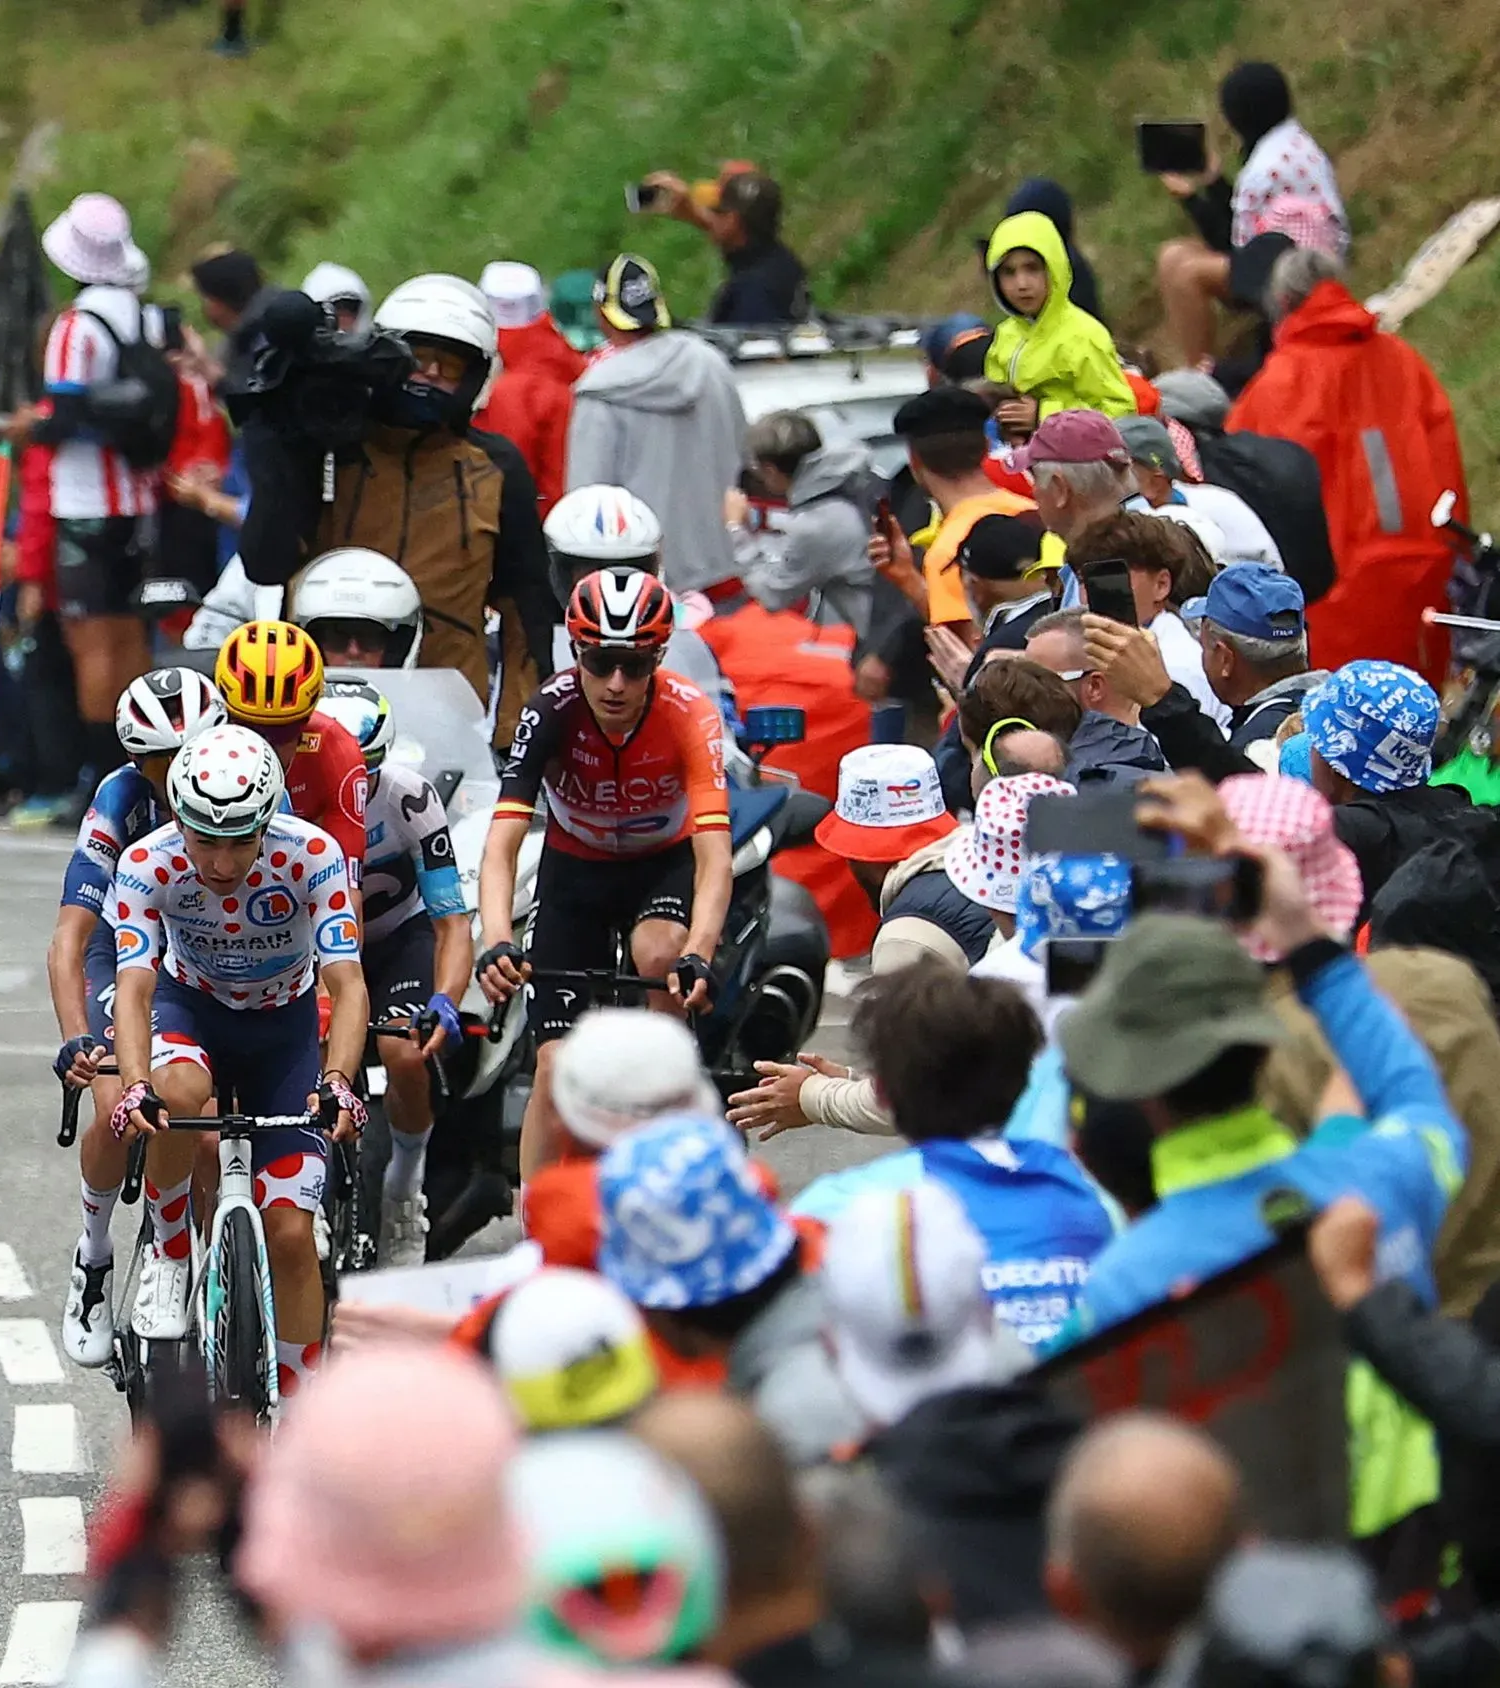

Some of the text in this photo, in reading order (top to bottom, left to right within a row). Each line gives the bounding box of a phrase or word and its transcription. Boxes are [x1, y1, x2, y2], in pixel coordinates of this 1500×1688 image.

[1378, 686, 1409, 714] Krys
[501, 706, 541, 779] INEOS
[556, 771, 681, 803] INEOS
[179, 928, 293, 948] BAHRAIN
